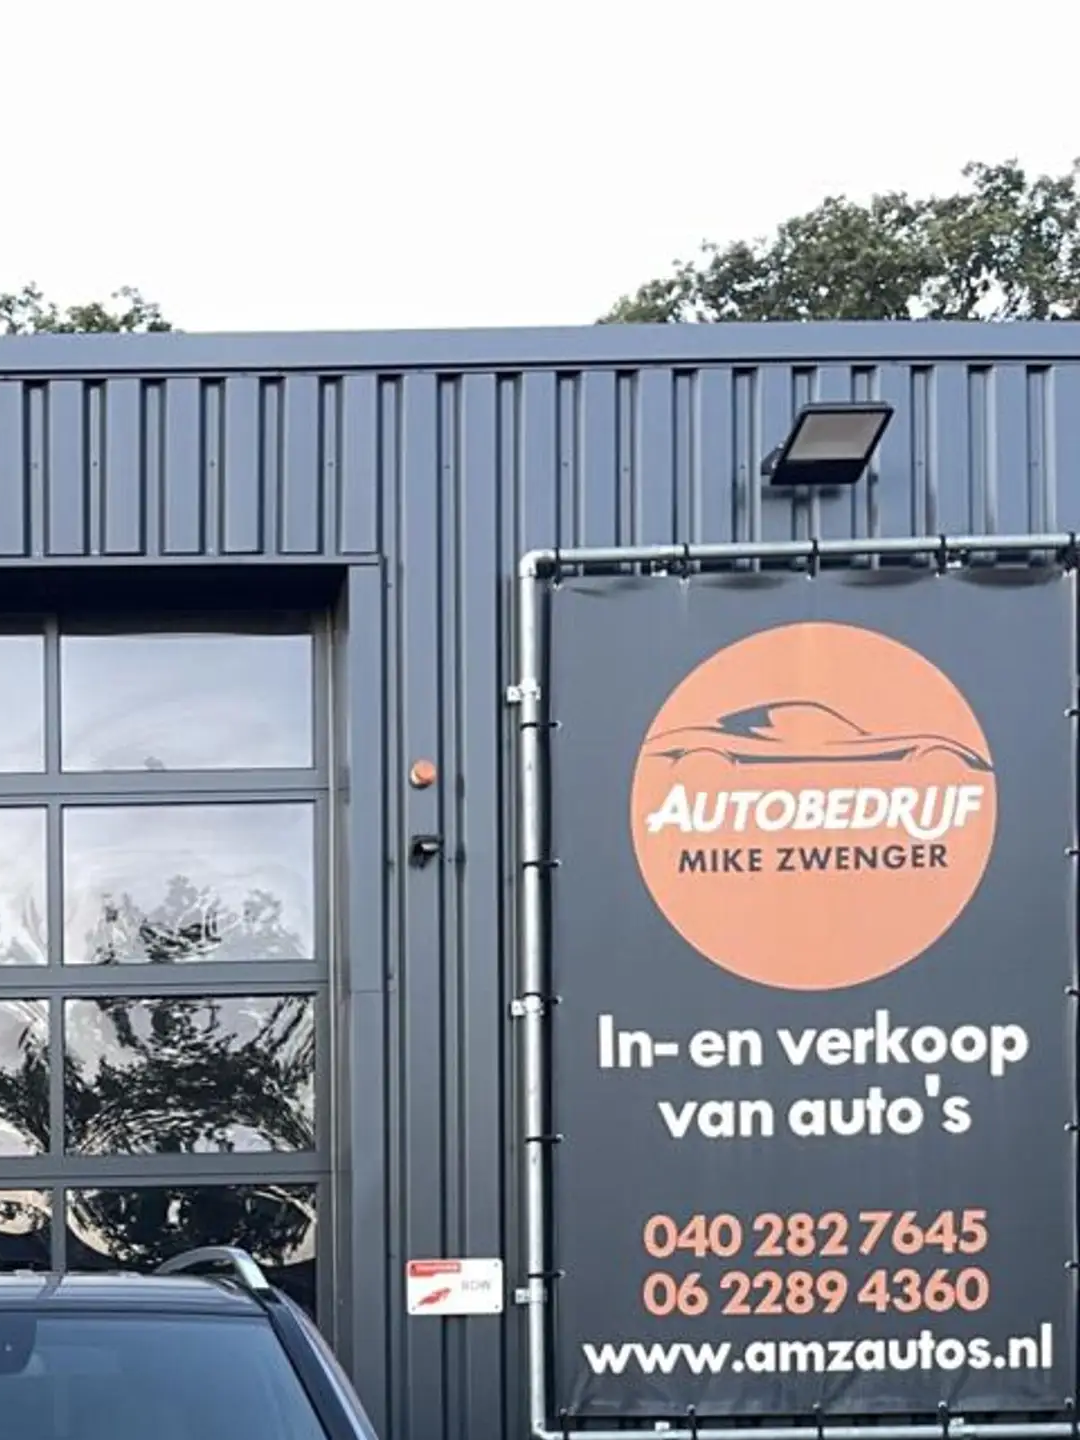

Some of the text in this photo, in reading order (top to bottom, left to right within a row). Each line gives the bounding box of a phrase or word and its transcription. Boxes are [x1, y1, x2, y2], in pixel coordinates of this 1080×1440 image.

[646, 783, 984, 840] AUTOBEDRIJF
[678, 844, 949, 874] MIKE ZWENGER
[689, 1029, 763, 1068] en
[776, 1009, 1029, 1076] verkoop
[658, 1073, 972, 1138] van auto's
[644, 1209, 988, 1257] 040 282 7645
[644, 1267, 989, 1316] 06 2289 4360
[583, 1323, 1052, 1374] www.amzautos.nl
